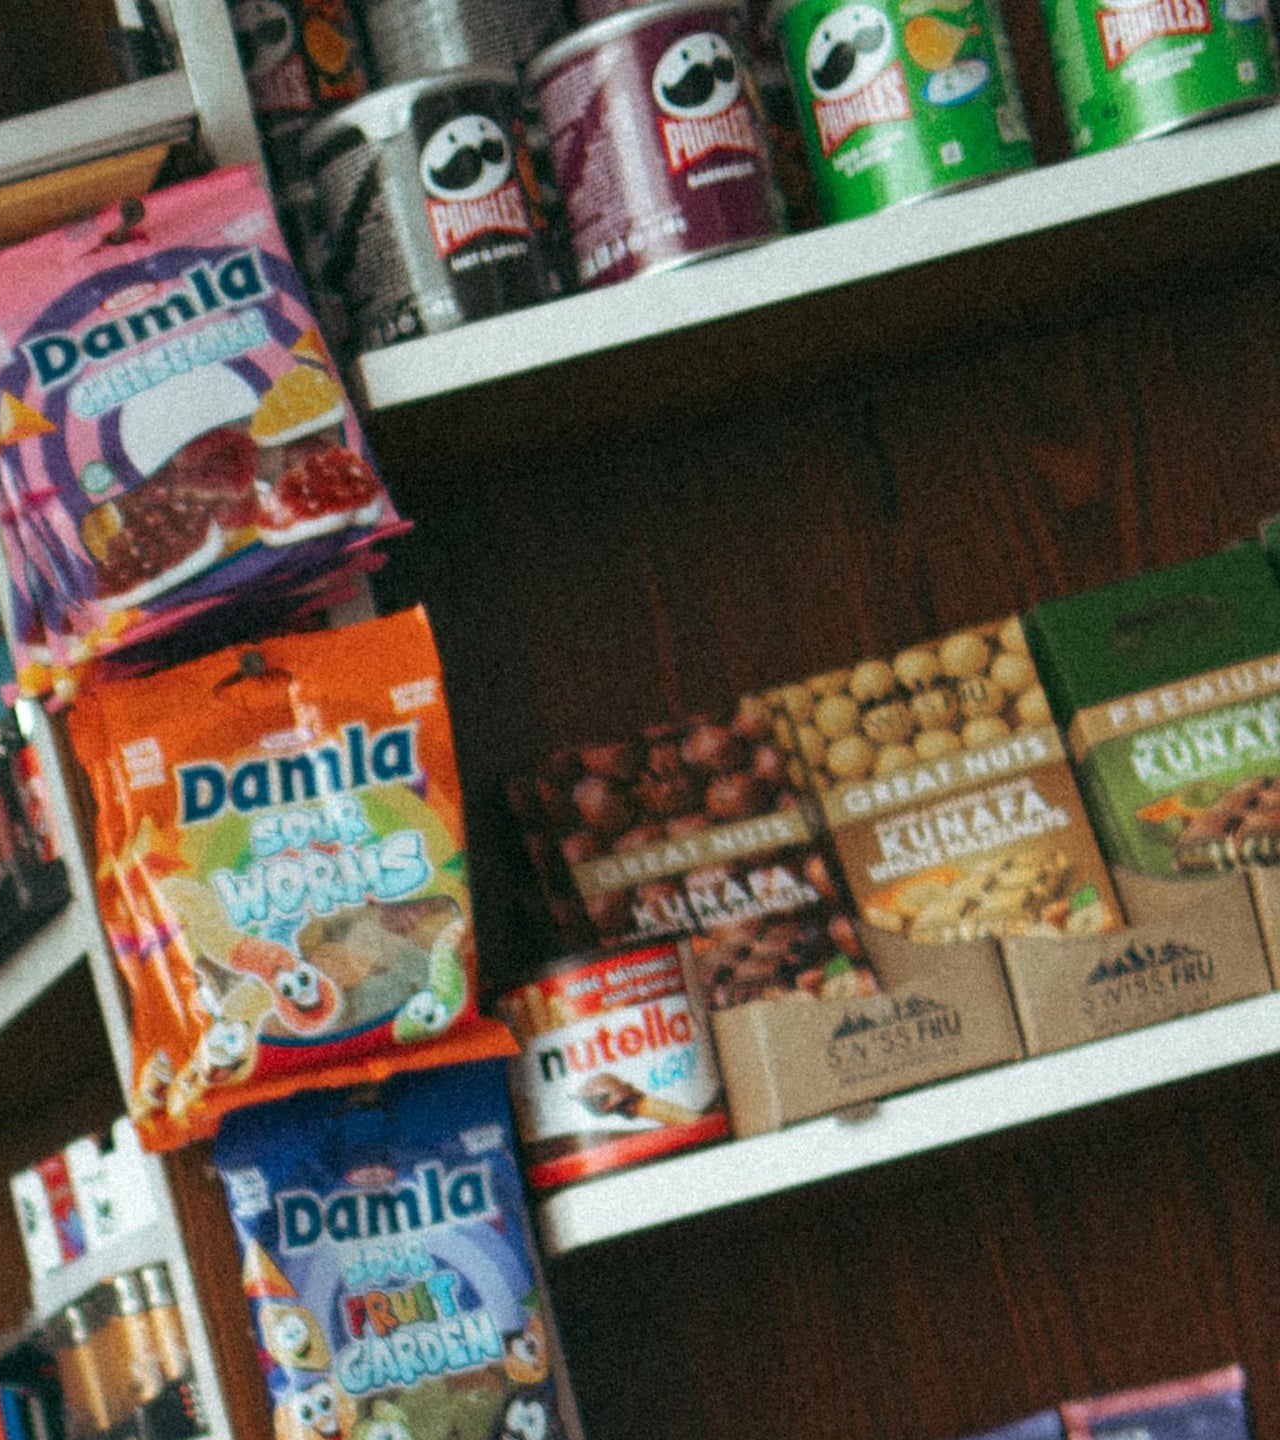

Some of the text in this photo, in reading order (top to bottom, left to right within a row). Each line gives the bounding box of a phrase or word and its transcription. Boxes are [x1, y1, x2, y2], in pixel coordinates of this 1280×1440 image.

[29, 257, 265, 381] Damla
[180, 727, 413, 821] Damla
[845, 766, 953, 812] GREAT
[967, 737, 1046, 778] NUTS
[251, 800, 369, 858] SOUR
[597, 819, 790, 886] GREAT NUTS
[880, 789, 1049, 857] KUNAFA
[214, 832, 429, 924] WORMS
[540, 1005, 696, 1082] nutella
[281, 1167, 488, 1247] Damla
[343, 1241, 429, 1284] SOUR
[347, 1273, 457, 1337] FRUIT
[341, 1316, 503, 1394] GARDEN
